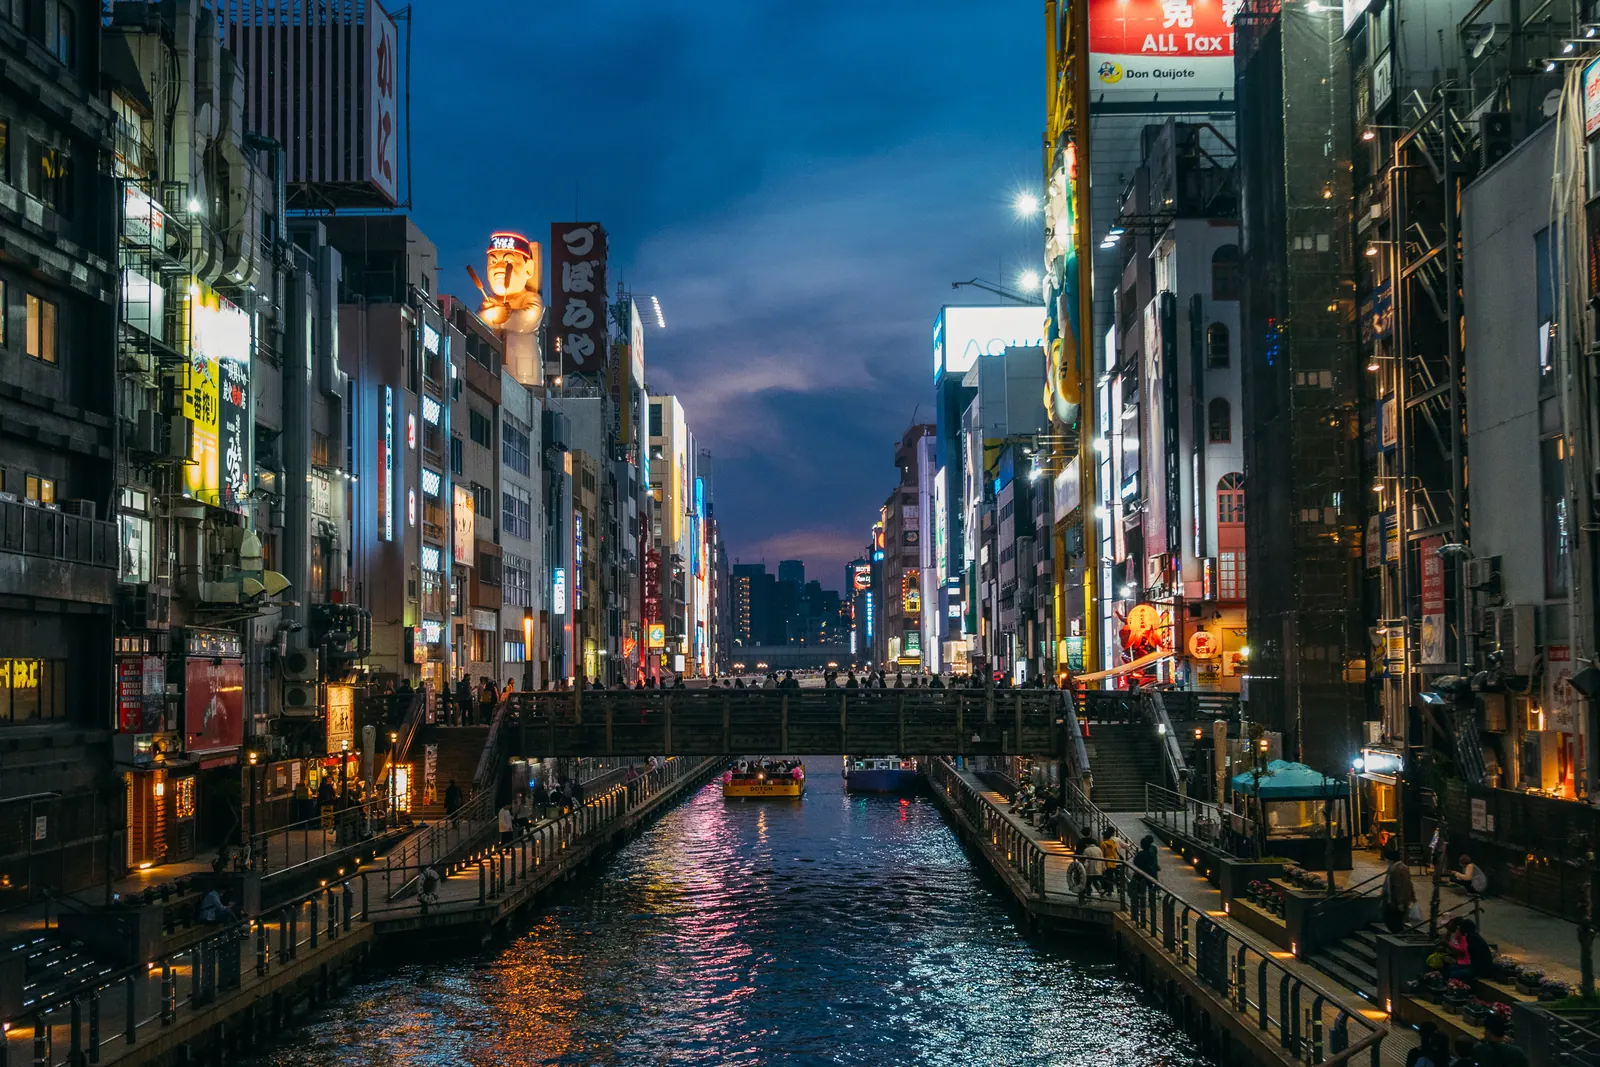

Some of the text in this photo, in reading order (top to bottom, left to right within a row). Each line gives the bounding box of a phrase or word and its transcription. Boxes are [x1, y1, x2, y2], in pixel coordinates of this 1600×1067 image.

[1141, 33, 1179, 53] ALL
[1184, 33, 1223, 52] Tax
[1126, 68, 1195, 80] Don Quijote
[562, 224, 600, 365] づぼらや
[186, 387, 217, 426] 一番搾り
